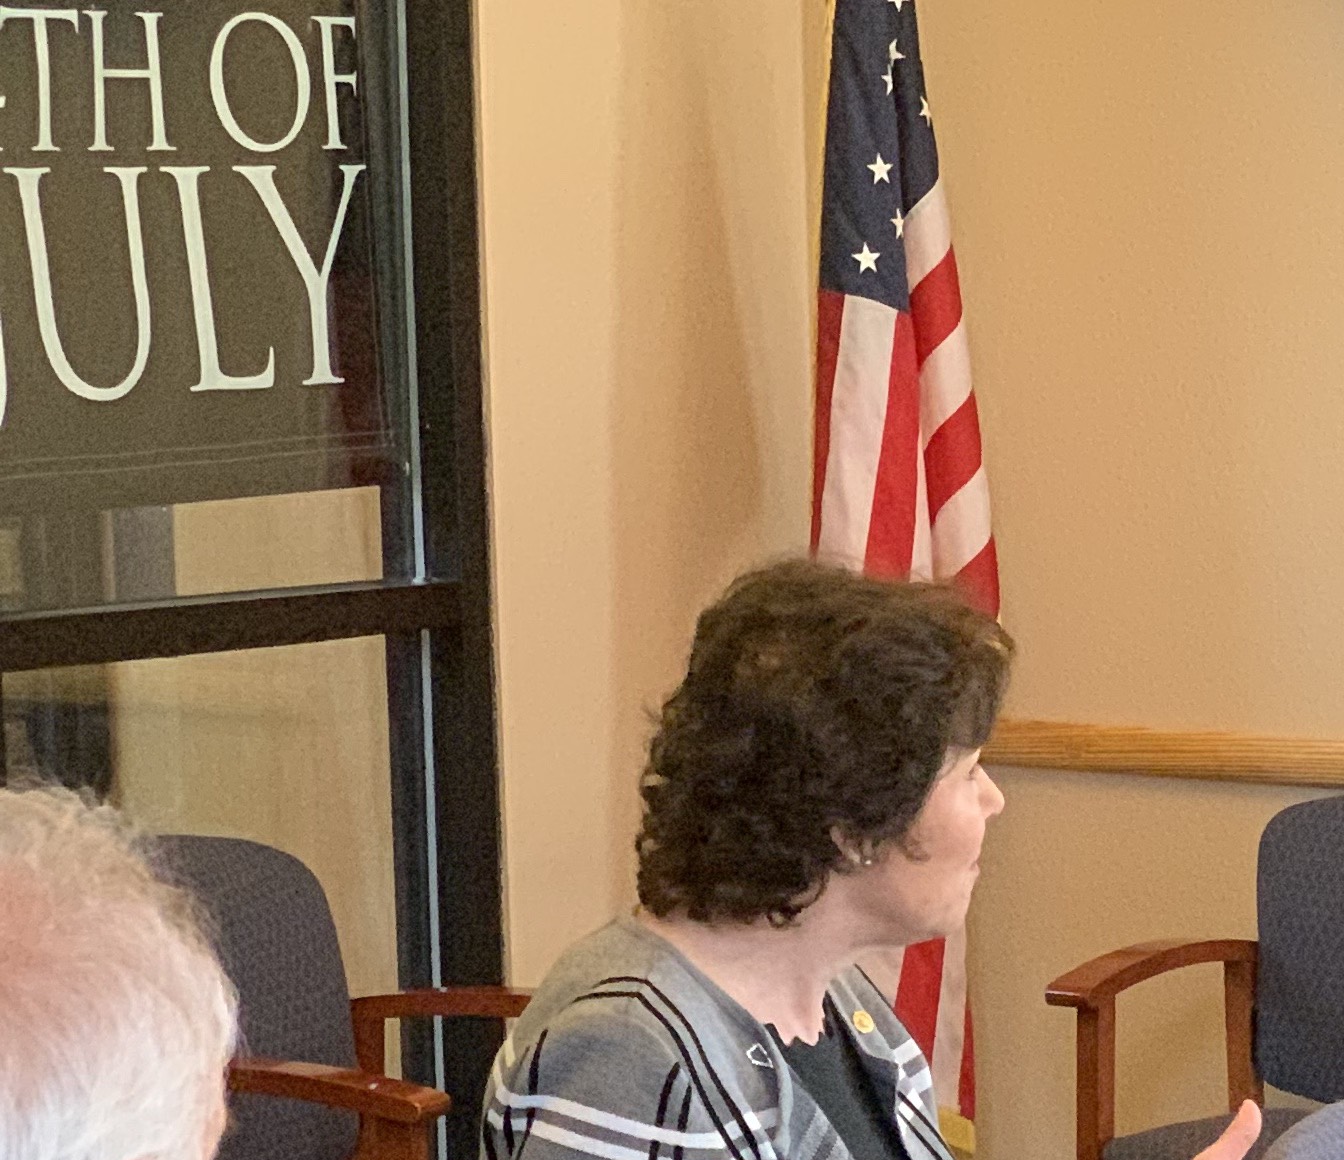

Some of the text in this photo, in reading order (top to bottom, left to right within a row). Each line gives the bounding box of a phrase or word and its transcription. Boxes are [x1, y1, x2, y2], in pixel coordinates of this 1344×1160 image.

[0, 8, 358, 153] TH OF
[0, 164, 367, 427] ULY
